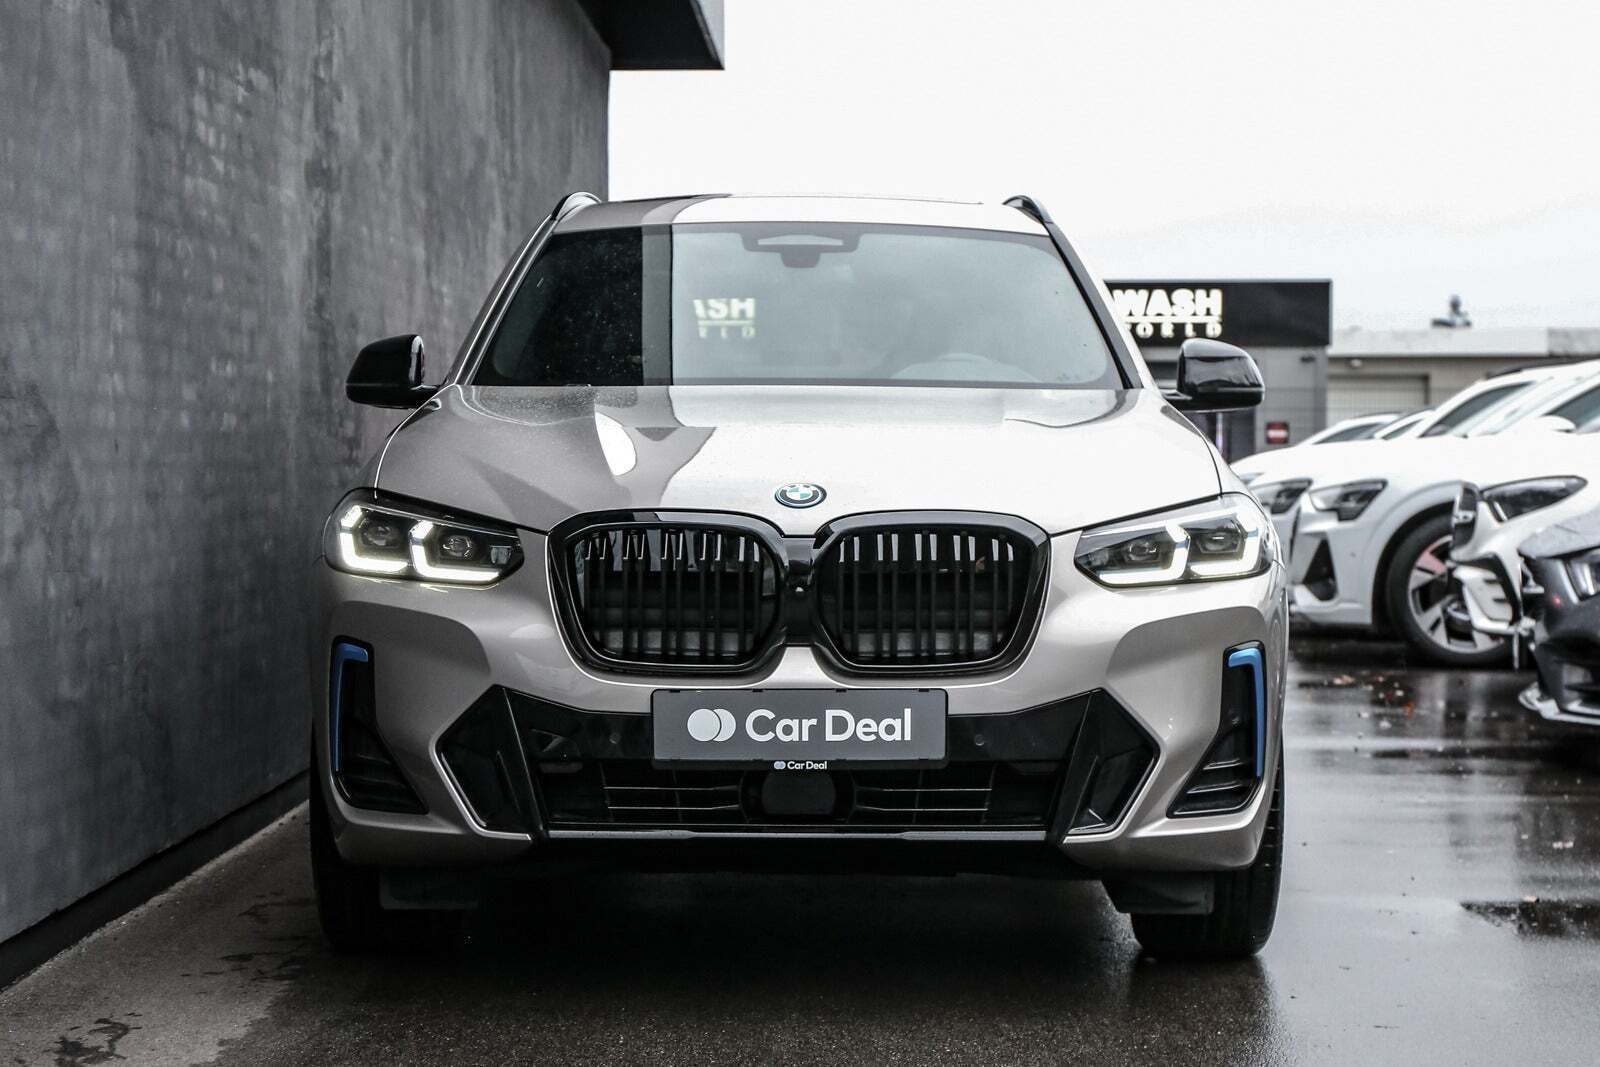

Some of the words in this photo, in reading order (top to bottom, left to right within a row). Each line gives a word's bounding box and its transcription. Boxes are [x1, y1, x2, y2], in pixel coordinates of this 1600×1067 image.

[1113, 288, 1222, 317] WASH
[745, 708, 817, 742] Car
[825, 708, 911, 742] Deal
[787, 761, 805, 770] Car
[806, 760, 828, 770] Deal
